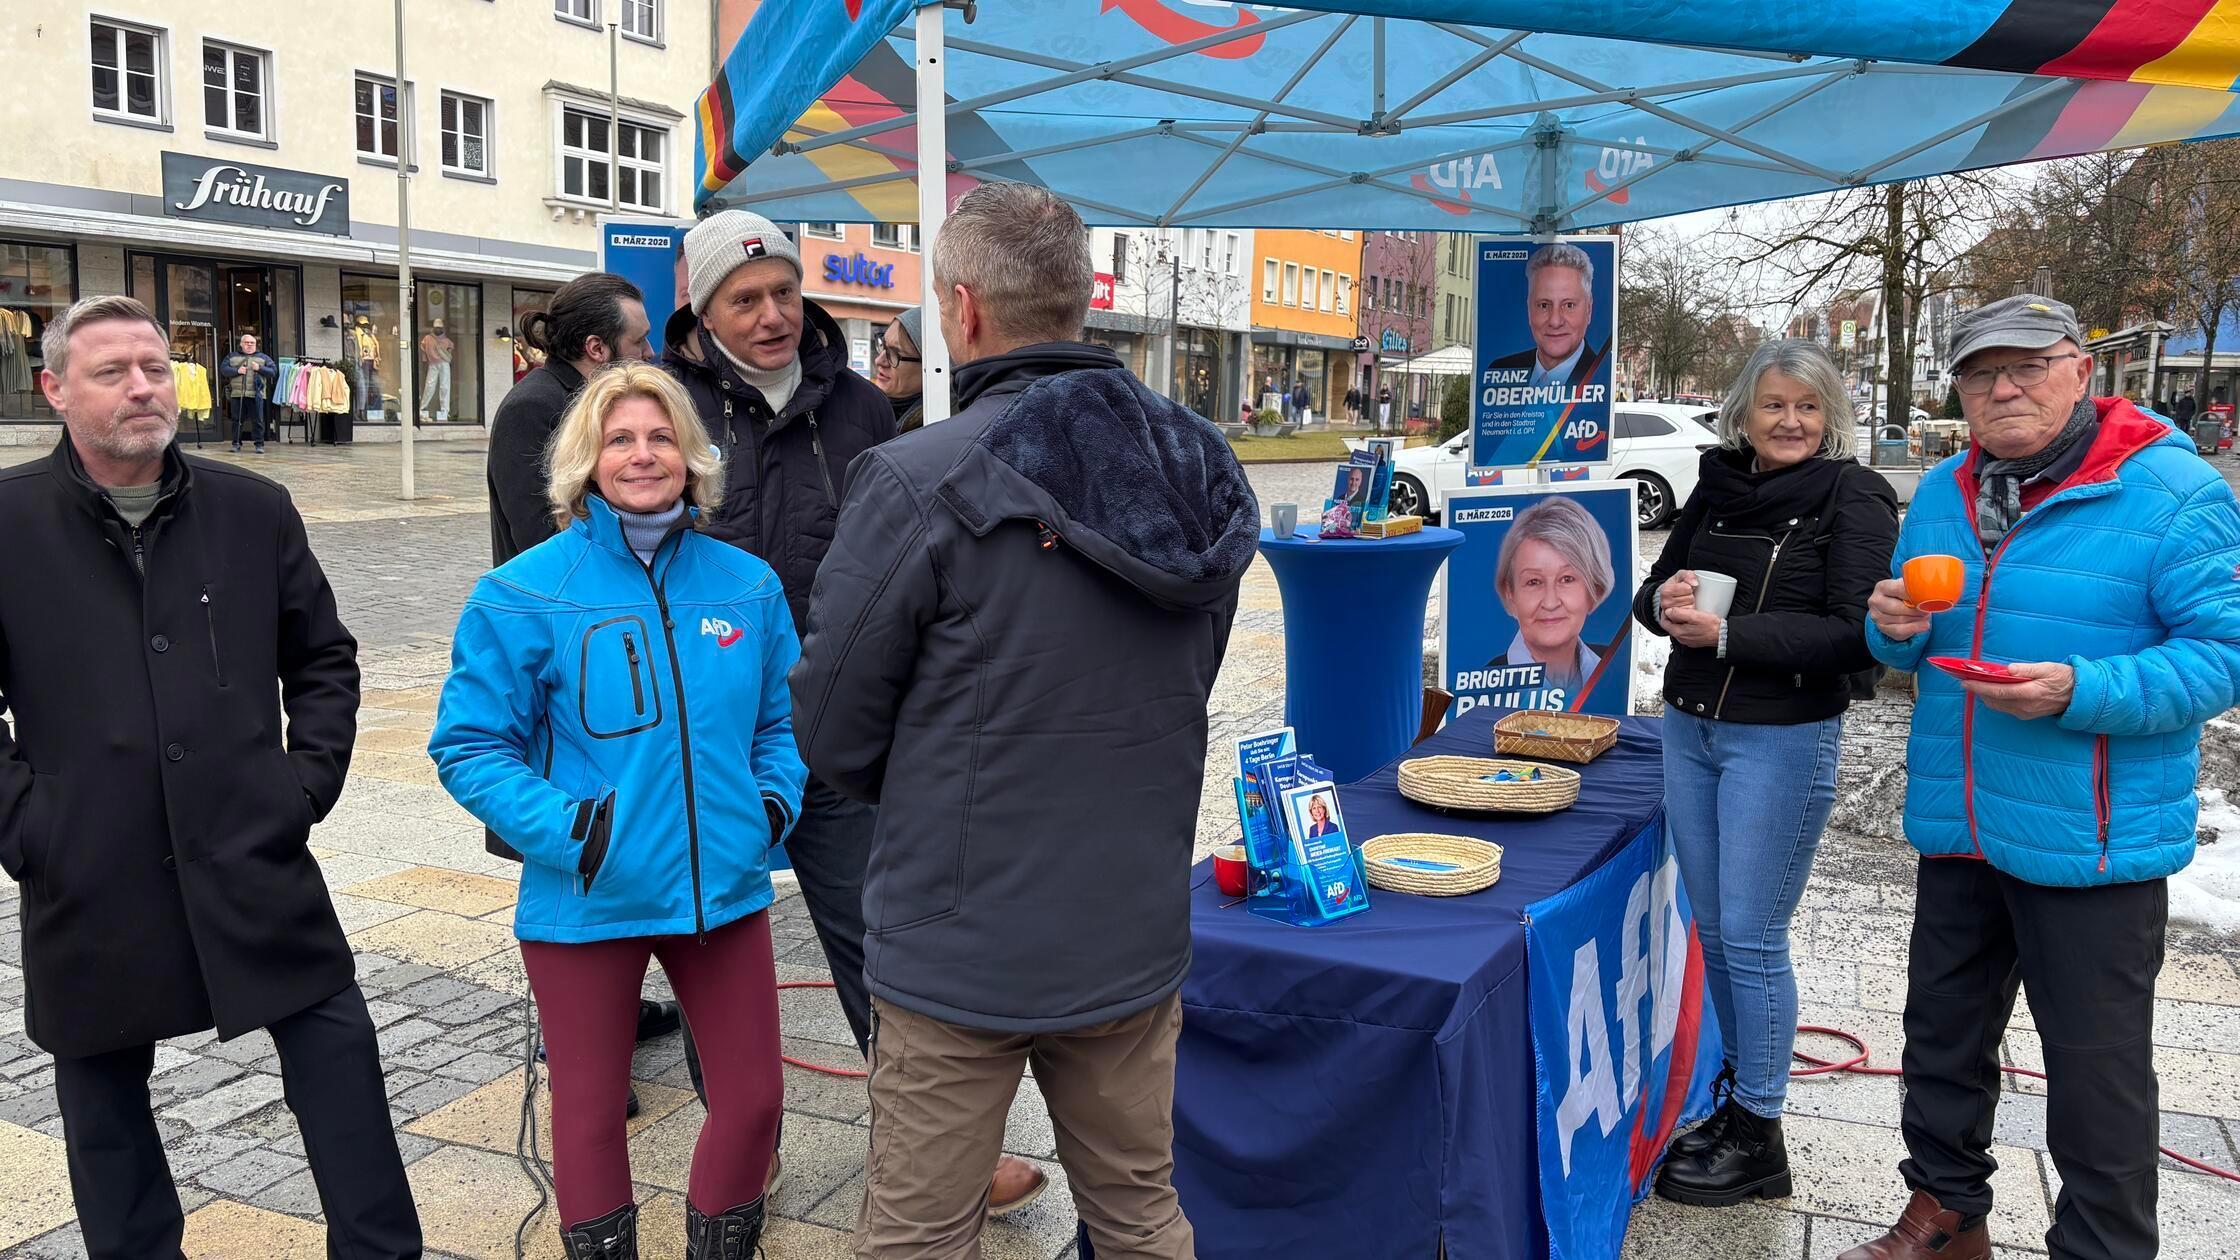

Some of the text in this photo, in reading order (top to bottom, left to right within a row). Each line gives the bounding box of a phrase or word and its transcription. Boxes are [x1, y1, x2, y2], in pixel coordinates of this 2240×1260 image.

[622, 235, 647, 245] MÄRZ
[1482, 369, 1529, 384] FRANZ
[1482, 380, 1606, 407] OBERMÜLLER
[1481, 420, 1493, 428] und
[1512, 419, 1536, 427] Stadtrat
[1509, 411, 1521, 419] den
[1521, 411, 1545, 420] Kreistag
[1481, 427, 1512, 436] Neumarkt
[1564, 418, 1598, 440] AfD
[1457, 508, 1512, 520] 8. MÄRZ 2026
[701, 617, 733, 637] AfD
[1455, 665, 1543, 691] BRIGITTE
[1327, 881, 1345, 898] AfD
[1556, 854, 1688, 1182] AfD
